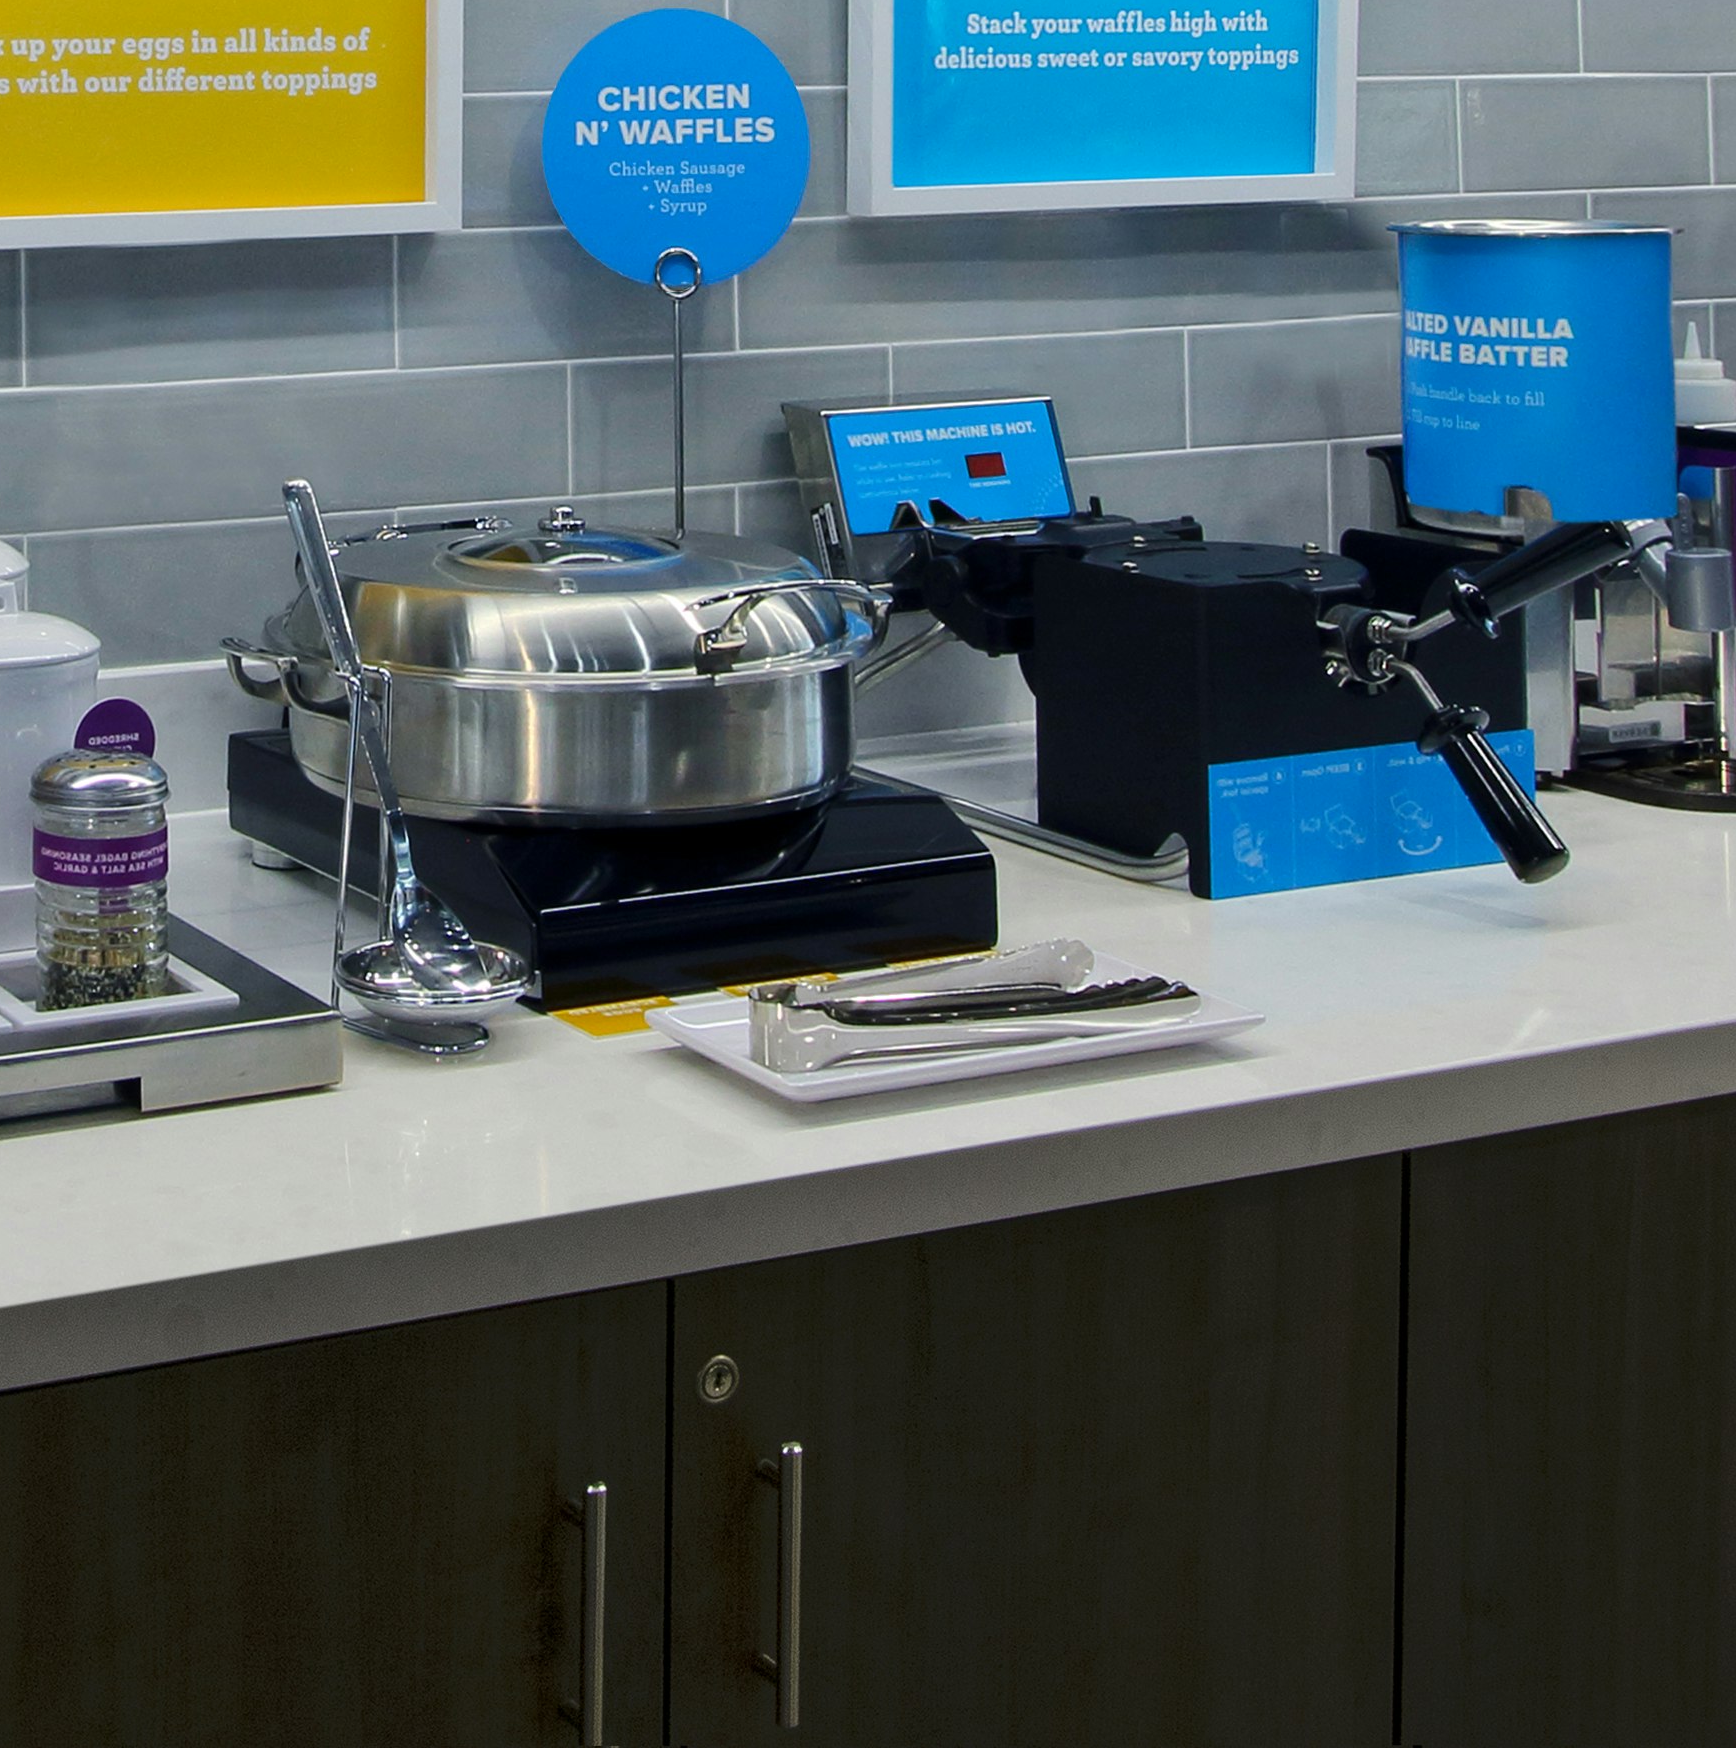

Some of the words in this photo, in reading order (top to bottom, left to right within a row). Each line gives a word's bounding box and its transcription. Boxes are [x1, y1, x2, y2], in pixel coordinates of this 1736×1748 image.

[967, 12, 1027, 34] Stack
[1031, 19, 1082, 39] your
[1086, 11, 1166, 32] waffles
[1170, 10, 1217, 37] high
[1222, 10, 1268, 31] with
[10, 39, 46, 62] up
[51, 38, 117, 62] your
[122, 37, 185, 61] eggs
[191, 29, 218, 54] in
[224, 28, 257, 53] all
[263, 27, 337, 52] kinds
[342, 27, 371, 52] of
[935, 46, 1032, 68] delicious
[1037, 50, 1099, 67] sweet
[1104, 52, 1127, 66] or
[1132, 51, 1203, 71] savory
[1207, 44, 1298, 70] toppings
[16, 69, 78, 94] with
[84, 76, 132, 93] our
[138, 67, 256, 92] different
[261, 67, 377, 96] toppings
[598, 83, 750, 112] CHICKEN
[619, 117, 775, 145] WAFFLES
[609, 161, 675, 177] Chicken
[680, 161, 745, 178] Sausage
[655, 179, 713, 194] Waffles
[660, 199, 707, 215] Syrup
[1405, 310, 1448, 334] ALTED
[1454, 316, 1574, 339] VANILLA
[1405, 336, 1452, 362] AFFLE
[1459, 343, 1568, 367] BATTER
[1469, 388, 1501, 404] back
[1506, 394, 1520, 405] to
[1525, 391, 1545, 406] fill
[847, 432, 890, 447] WOW!
[892, 430, 924, 444] THIS
[926, 426, 988, 442] MACHINE
[991, 424, 1003, 435] IS
[1007, 421, 1036, 434] HOT.
[1442, 417, 1453, 428] to
[1456, 415, 1480, 430] line
